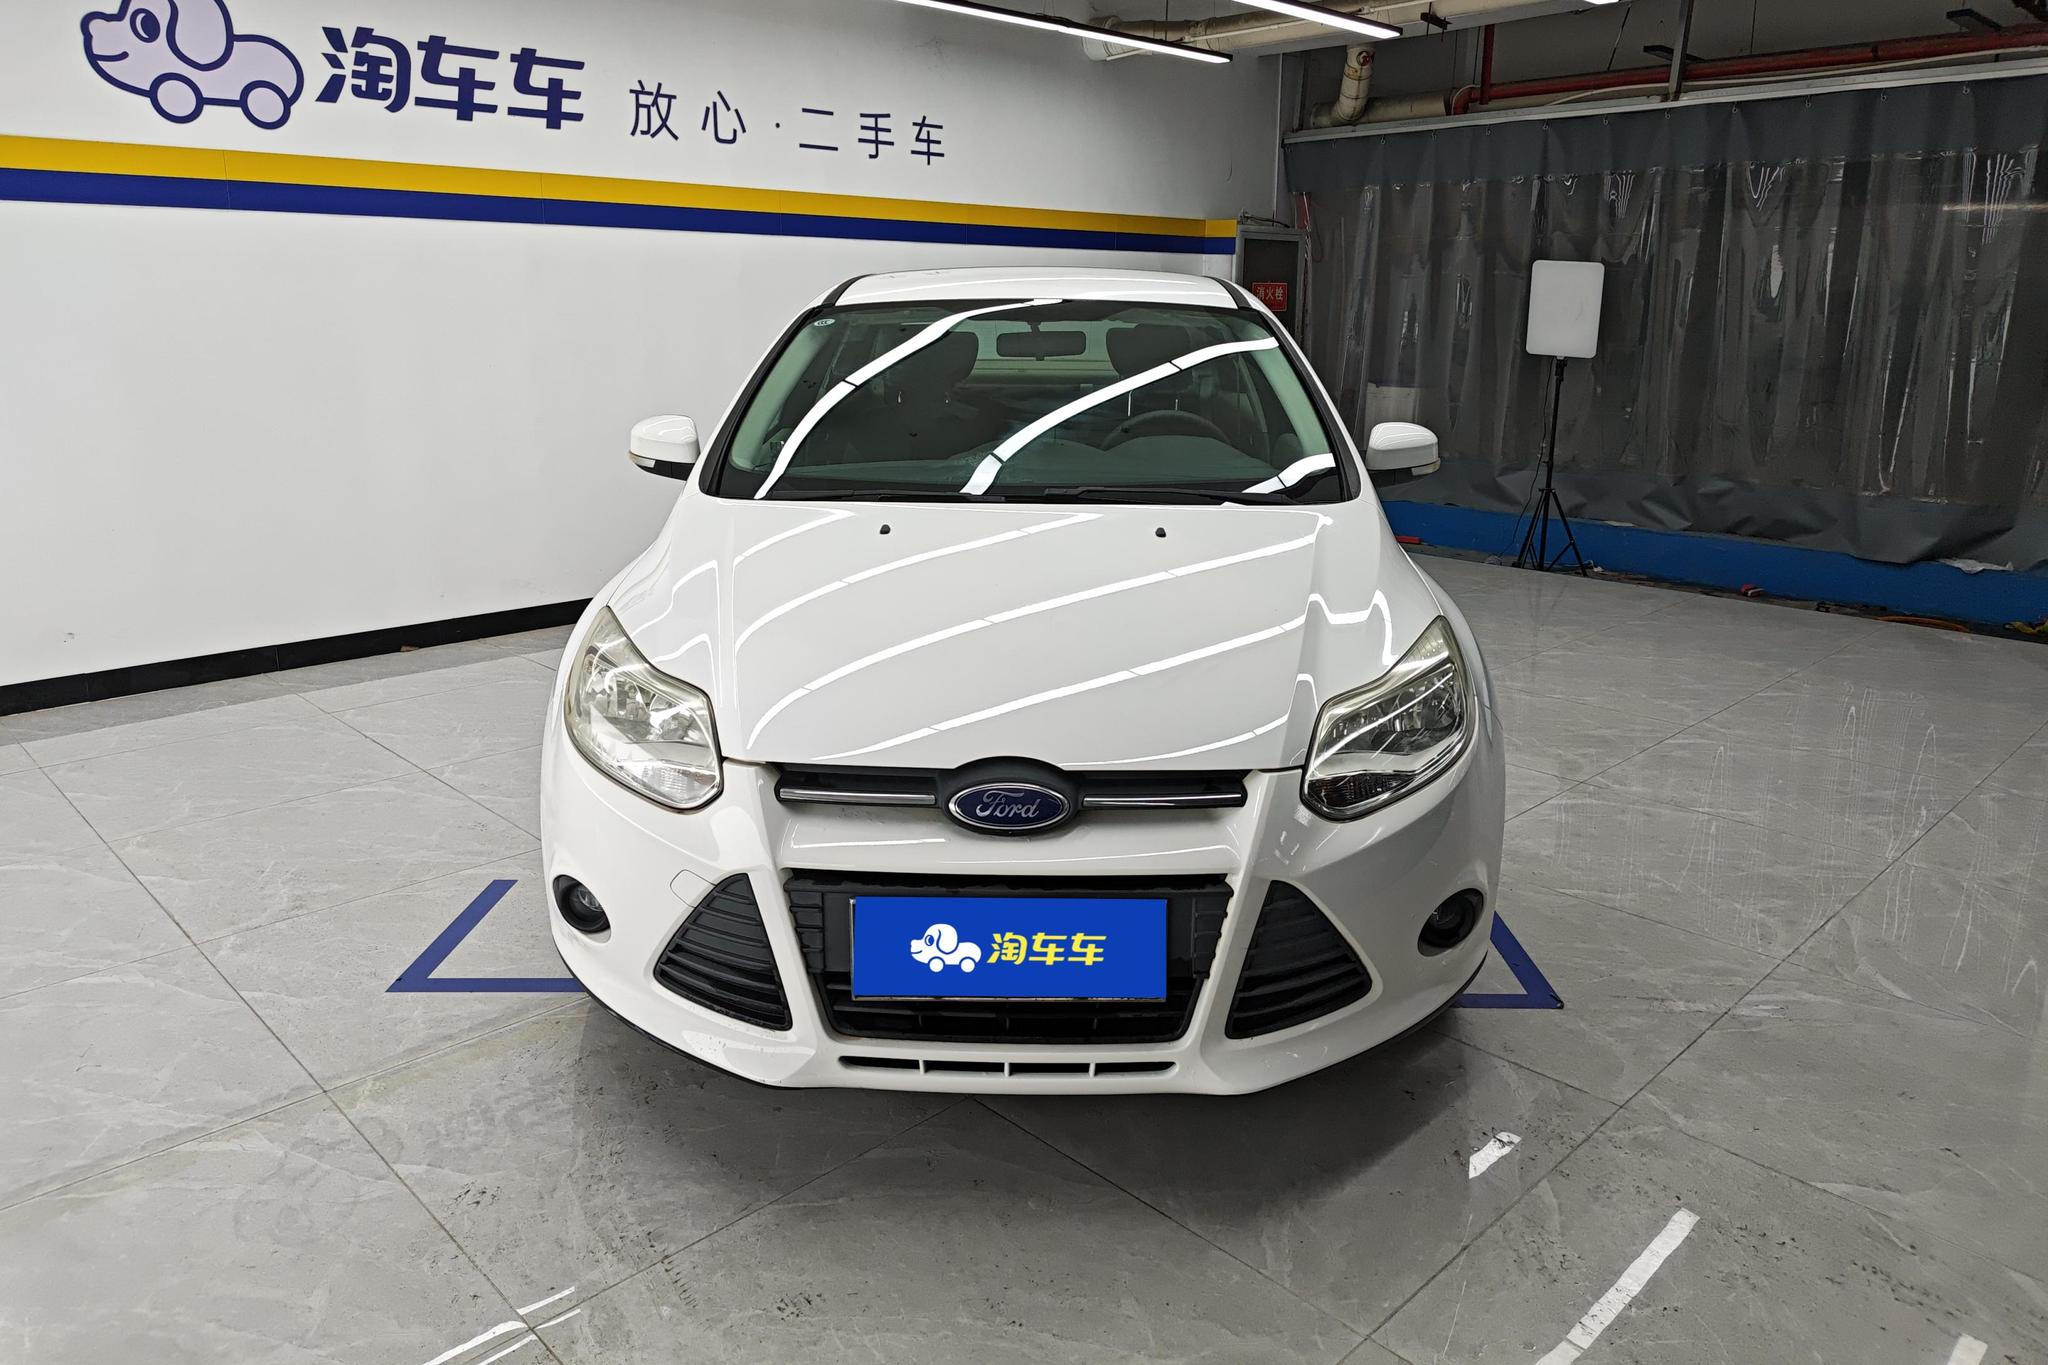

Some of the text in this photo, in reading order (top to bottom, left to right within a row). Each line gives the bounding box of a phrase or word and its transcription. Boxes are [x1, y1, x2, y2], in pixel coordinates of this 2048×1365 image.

[316, 26, 585, 130] 淘车车
[1256, 286, 1285, 300] 消火栓
[976, 790, 1040, 819] Ford
